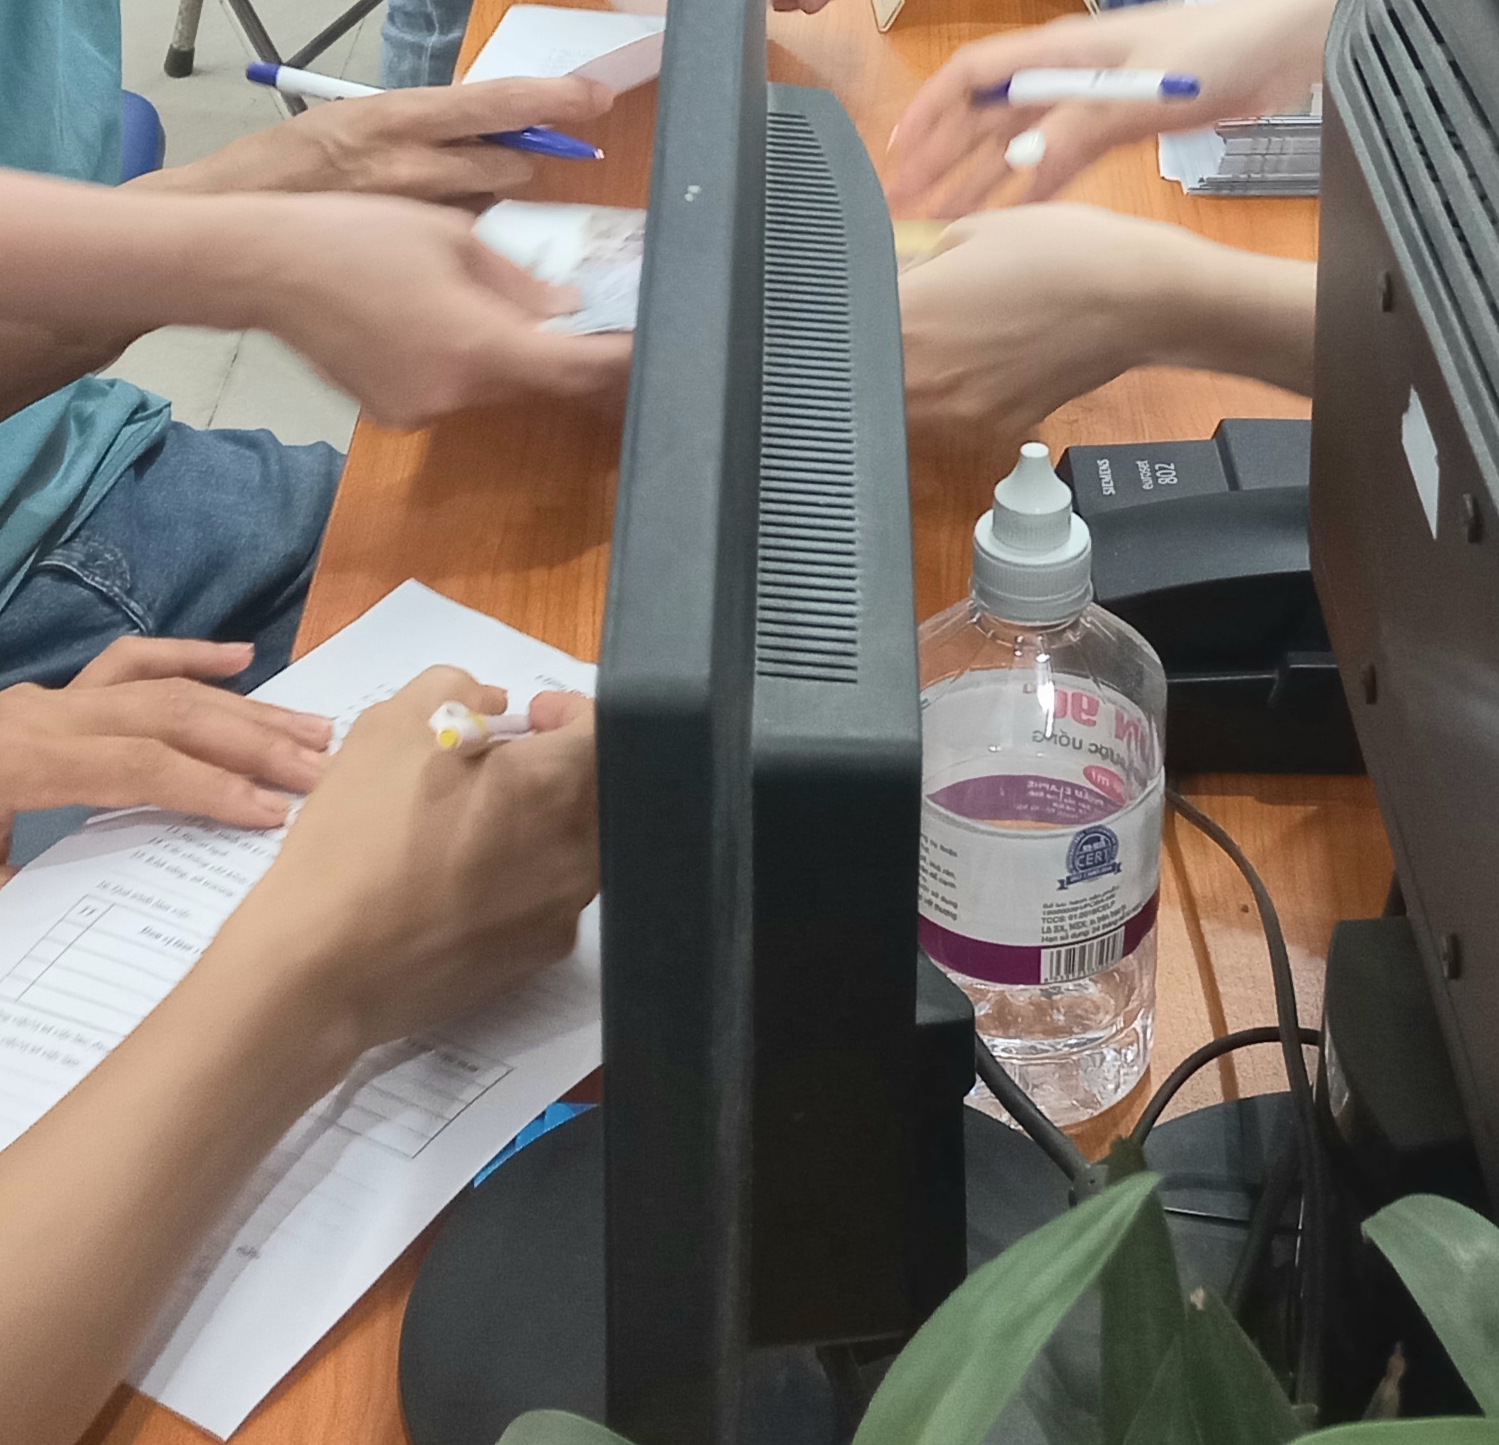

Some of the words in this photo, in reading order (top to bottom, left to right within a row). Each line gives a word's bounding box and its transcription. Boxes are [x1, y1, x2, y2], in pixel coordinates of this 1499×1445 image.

[1096, 458, 1115, 494] SIEMENS
[1135, 459, 1153, 489] euroset
[1154, 462, 1177, 484] 802
[1076, 850, 1109, 869] CERT
